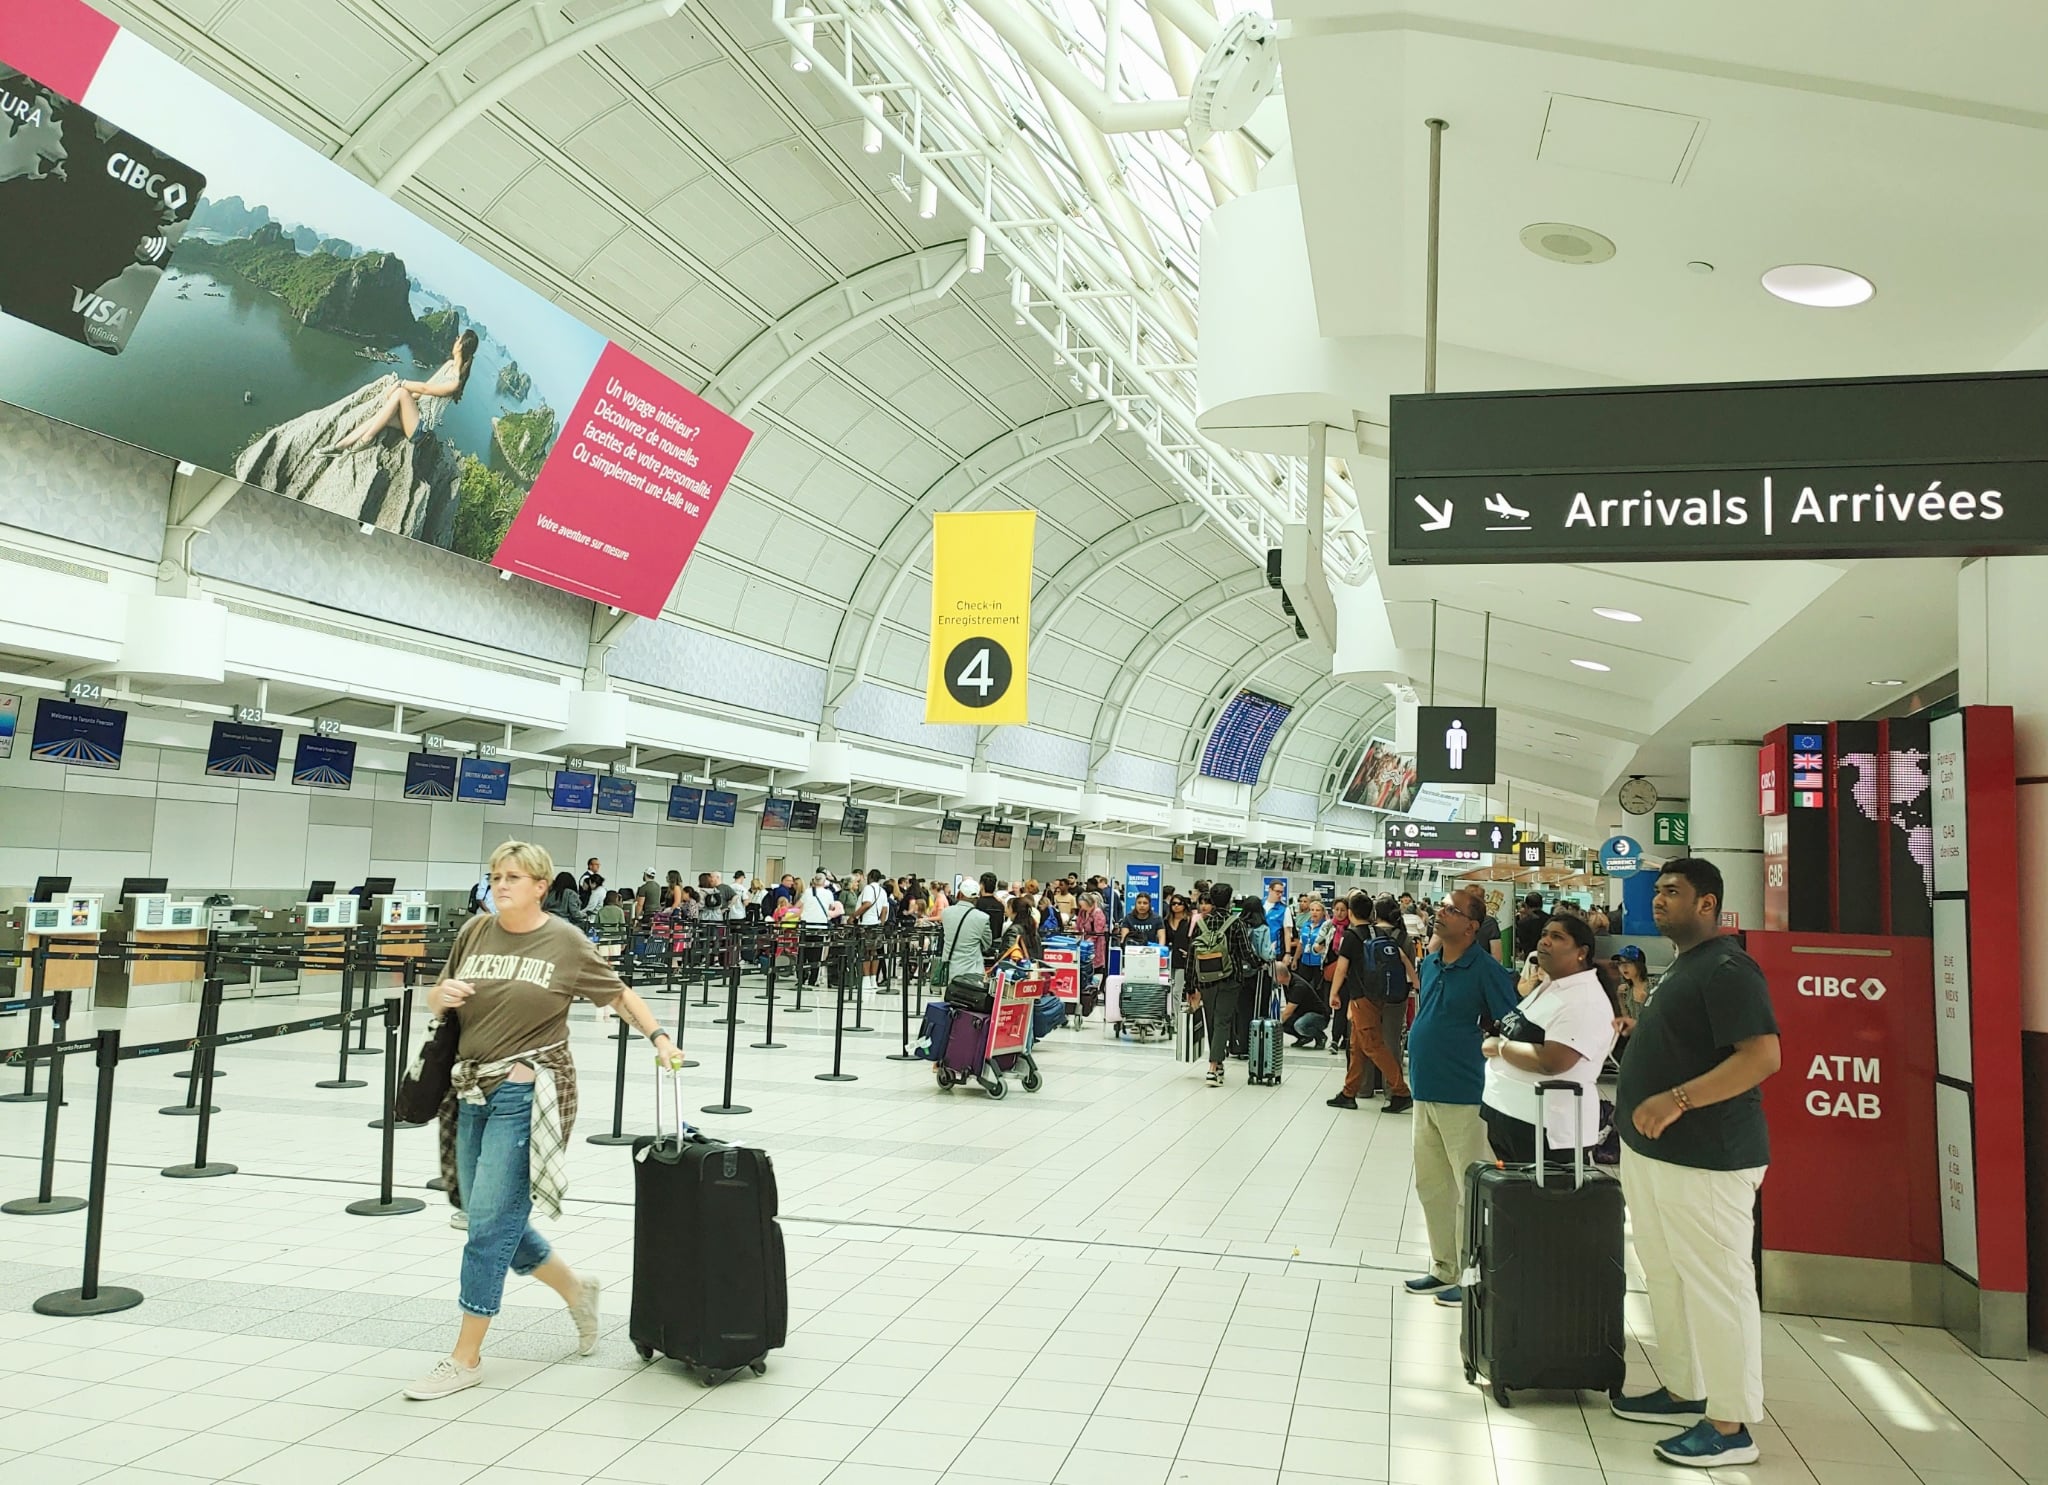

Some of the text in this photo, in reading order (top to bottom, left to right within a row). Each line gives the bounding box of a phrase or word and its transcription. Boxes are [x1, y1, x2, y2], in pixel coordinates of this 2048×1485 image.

[106, 152, 166, 199] CIBC
[72, 284, 130, 326] VISA
[87, 322, 119, 344] Infinite
[605, 376, 623, 399] Un
[622, 390, 657, 420] voyage
[594, 398, 699, 468] Découvrez de nouvelles
[583, 420, 712, 501] facettes de votre personnalité.
[572, 442, 700, 518] Ou simplement une belle vue.
[1564, 480, 2005, 528] Arrivals Arrivées
[536, 513, 630, 561] Votre aventure sur mesure
[956, 600, 1002, 611] Check-in
[938, 615, 1020, 627] Enregistrement
[957, 648, 994, 697] 4
[72, 683, 100, 699] 424
[51, 711, 72, 721] Welcome
[78, 715, 96, 725] Toronto
[240, 708, 261, 721] 423
[320, 720, 340, 733] 422
[428, 736, 442, 748] 421
[481, 744, 496, 756] 420
[570, 758, 582, 768] 419
[614, 764, 626, 774] 418
[683, 774, 694, 783] 417
[1940, 769, 1954, 784] Cash
[1941, 786, 1954, 801] ATM
[1769, 831, 1783, 856] ATM
[1768, 864, 1783, 888] GAB
[456, 954, 556, 989] JACKSON HOLE
[1797, 975, 1858, 998] CIBC
[1806, 1055, 1881, 1084] ATM
[1805, 1090, 1882, 1119] GAB
